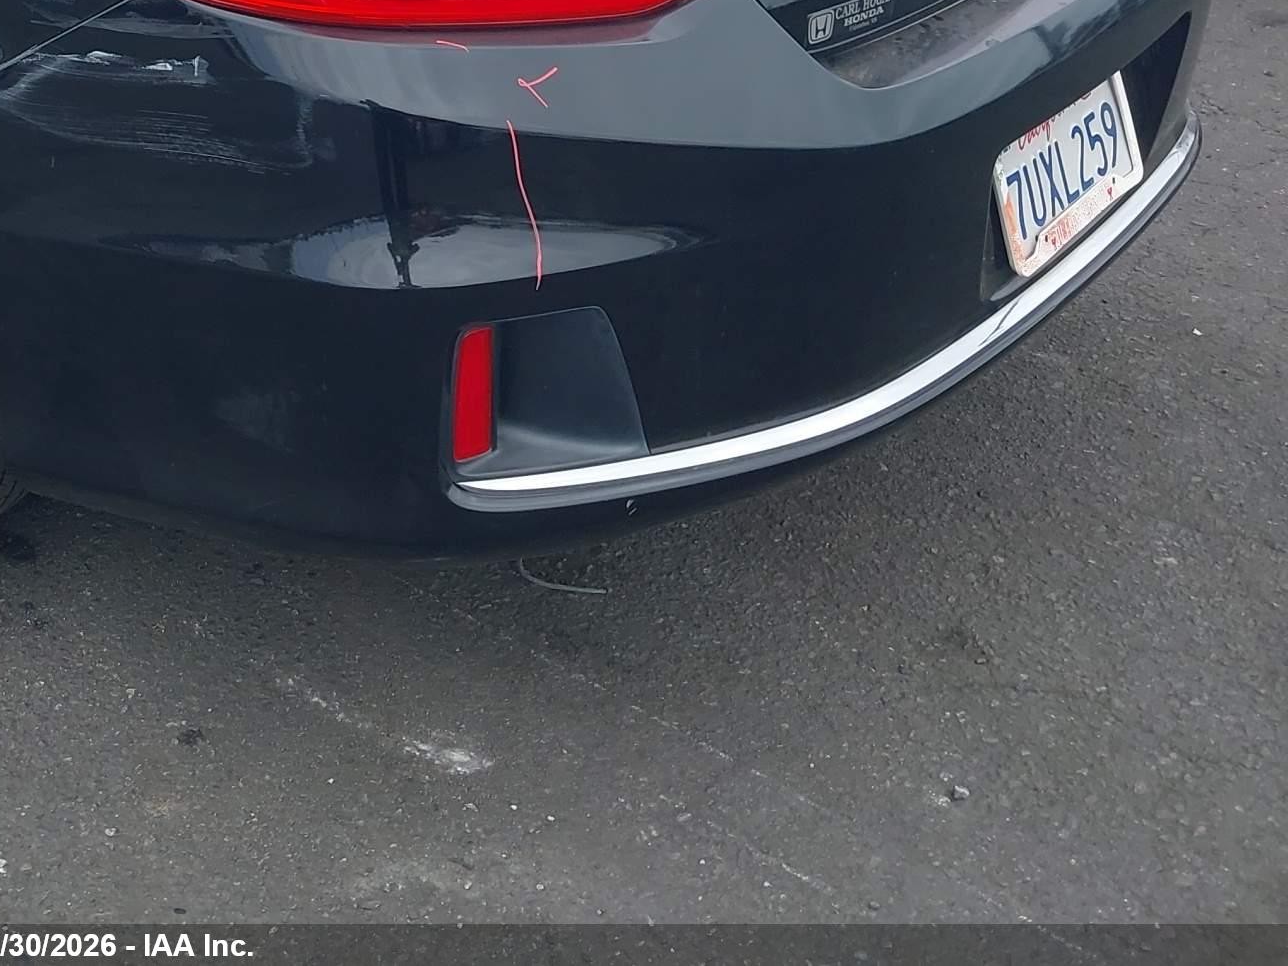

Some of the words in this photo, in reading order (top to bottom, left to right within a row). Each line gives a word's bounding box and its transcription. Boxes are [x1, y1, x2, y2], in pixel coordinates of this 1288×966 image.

[835, 1, 861, 20] CARL
[843, 6, 885, 27] HONDA
[1005, 101, 1118, 241] 7UXL259
